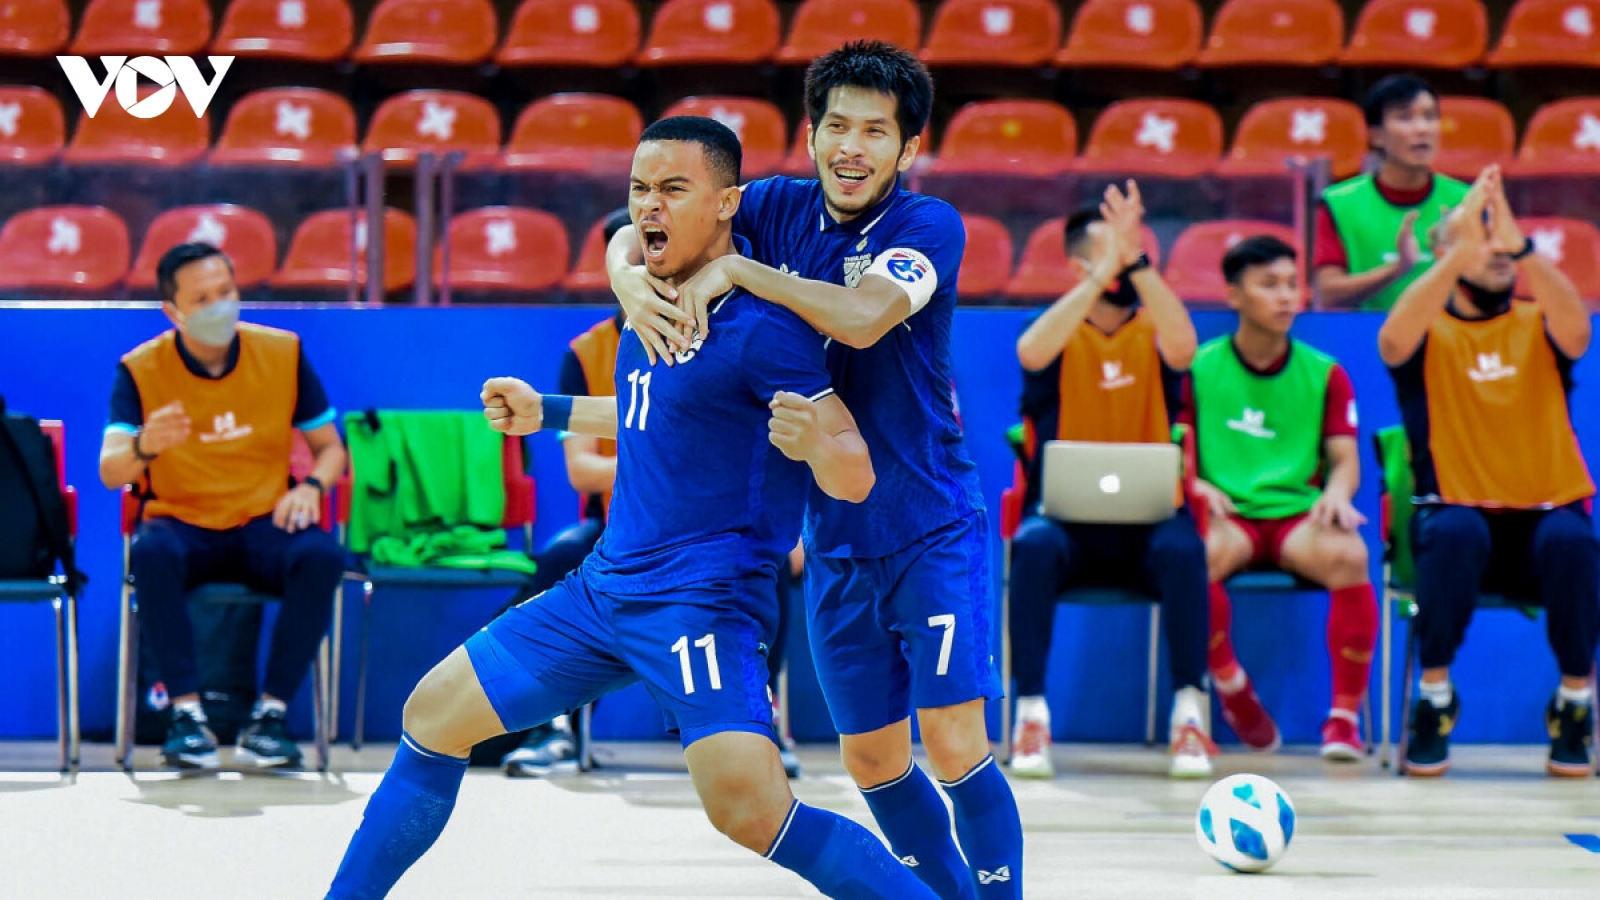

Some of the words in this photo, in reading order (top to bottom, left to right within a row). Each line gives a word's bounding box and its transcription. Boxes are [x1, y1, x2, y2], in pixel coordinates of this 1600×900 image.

[624, 369, 652, 431] 11
[671, 633, 722, 695] 11
[928, 614, 956, 676] 7
